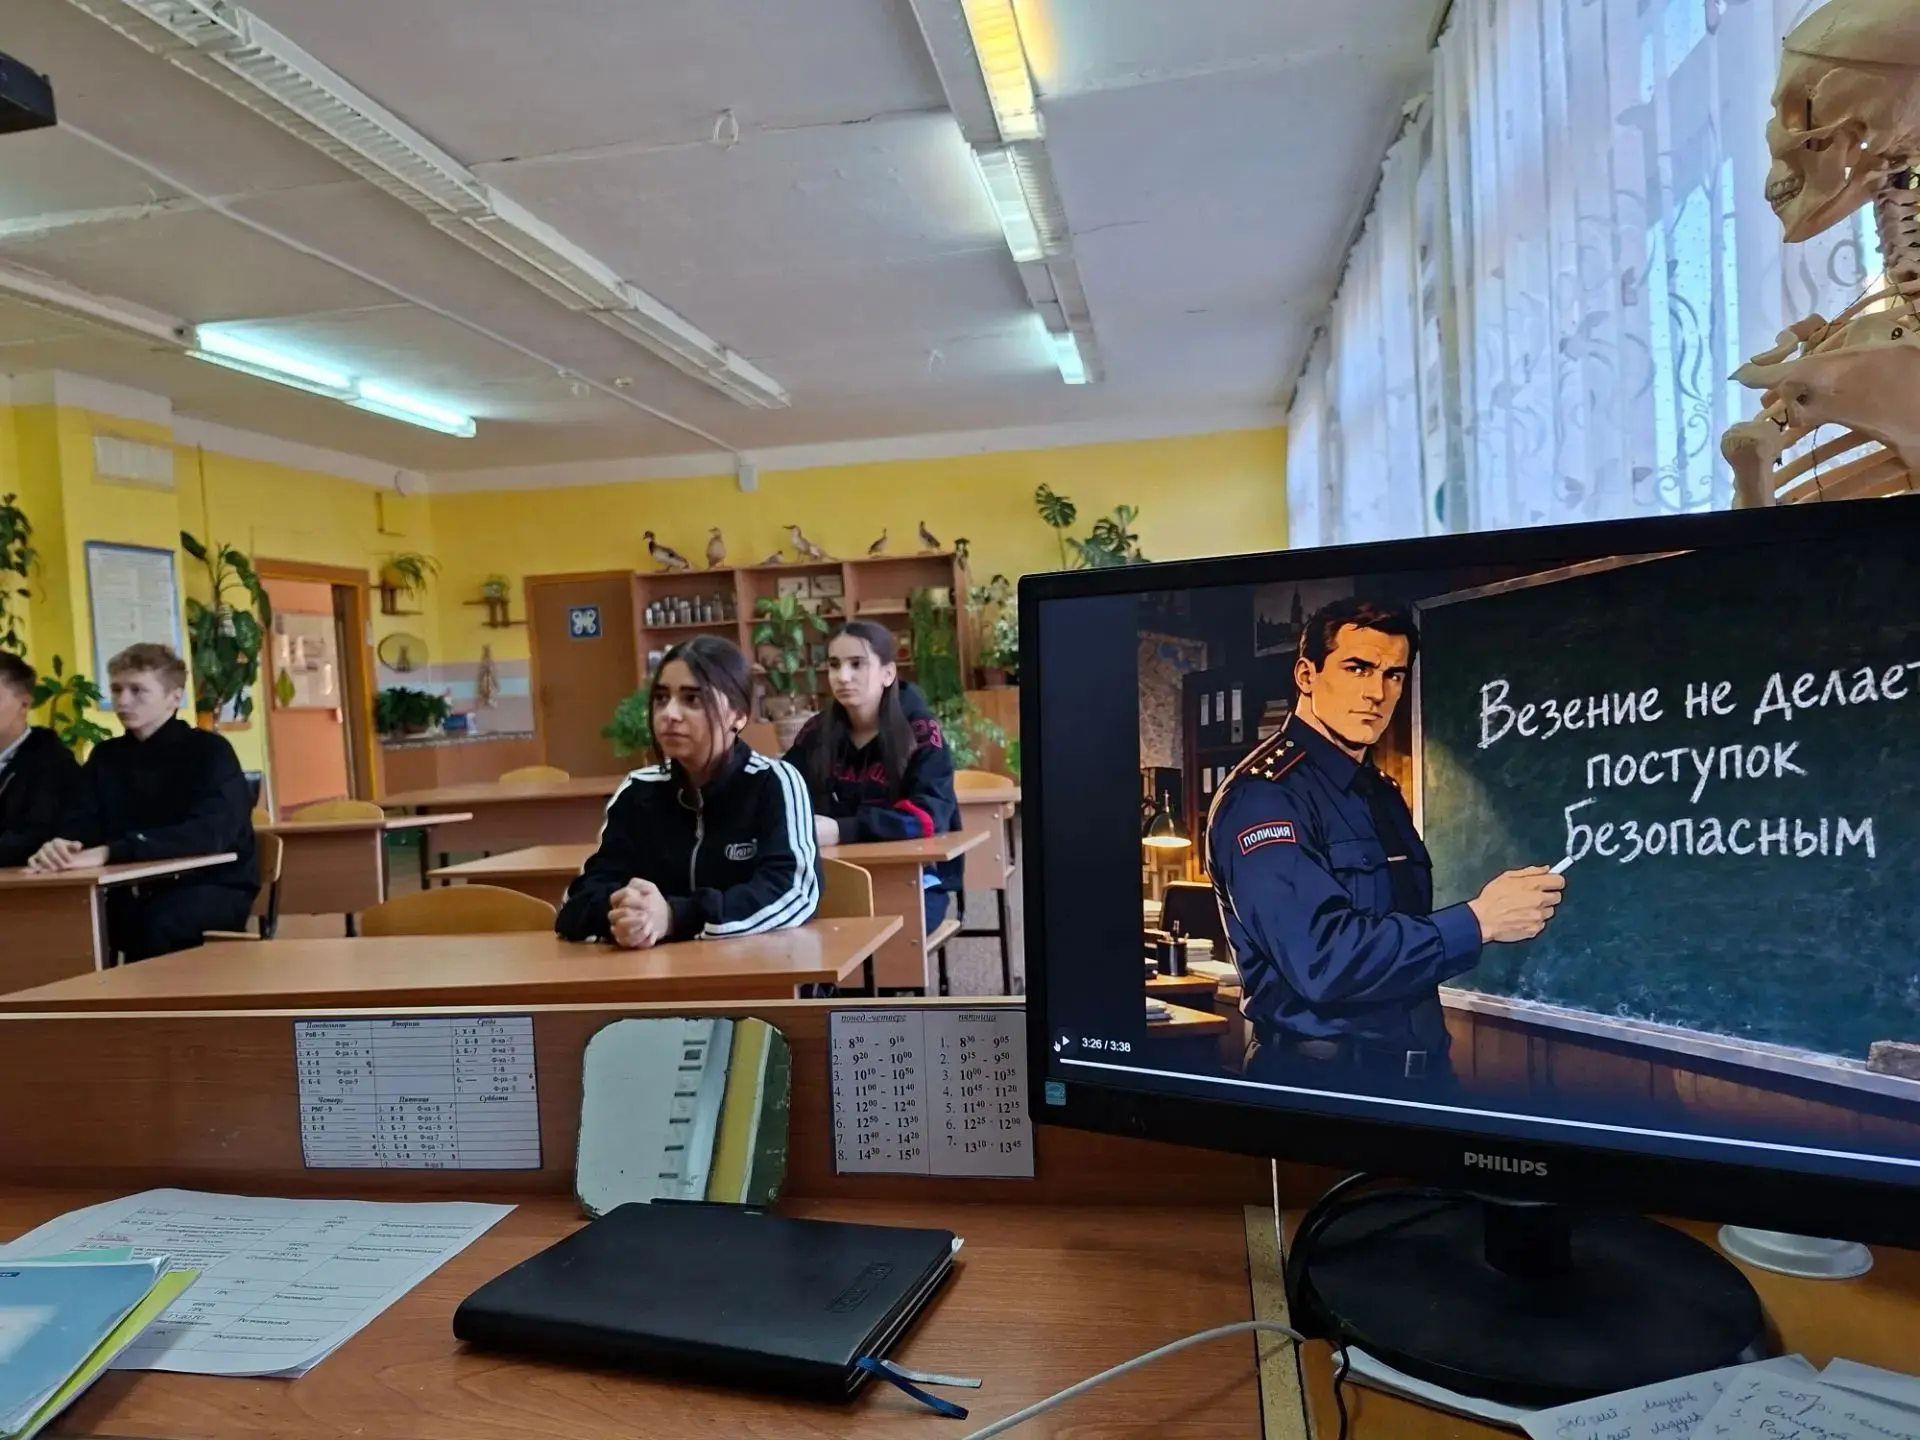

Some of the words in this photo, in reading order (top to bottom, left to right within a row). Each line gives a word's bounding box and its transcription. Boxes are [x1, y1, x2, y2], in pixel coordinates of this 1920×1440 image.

[1477, 679, 1664, 749] Везение
[1685, 680, 1736, 720] не
[1586, 741, 1808, 803] поступок
[1243, 826, 1291, 847] ПОЛИЦИЯ
[1081, 1037, 1102, 1049] 3:26
[1110, 1040, 1131, 1052] 3:38
[1464, 1151, 1548, 1176] PHILIPS
